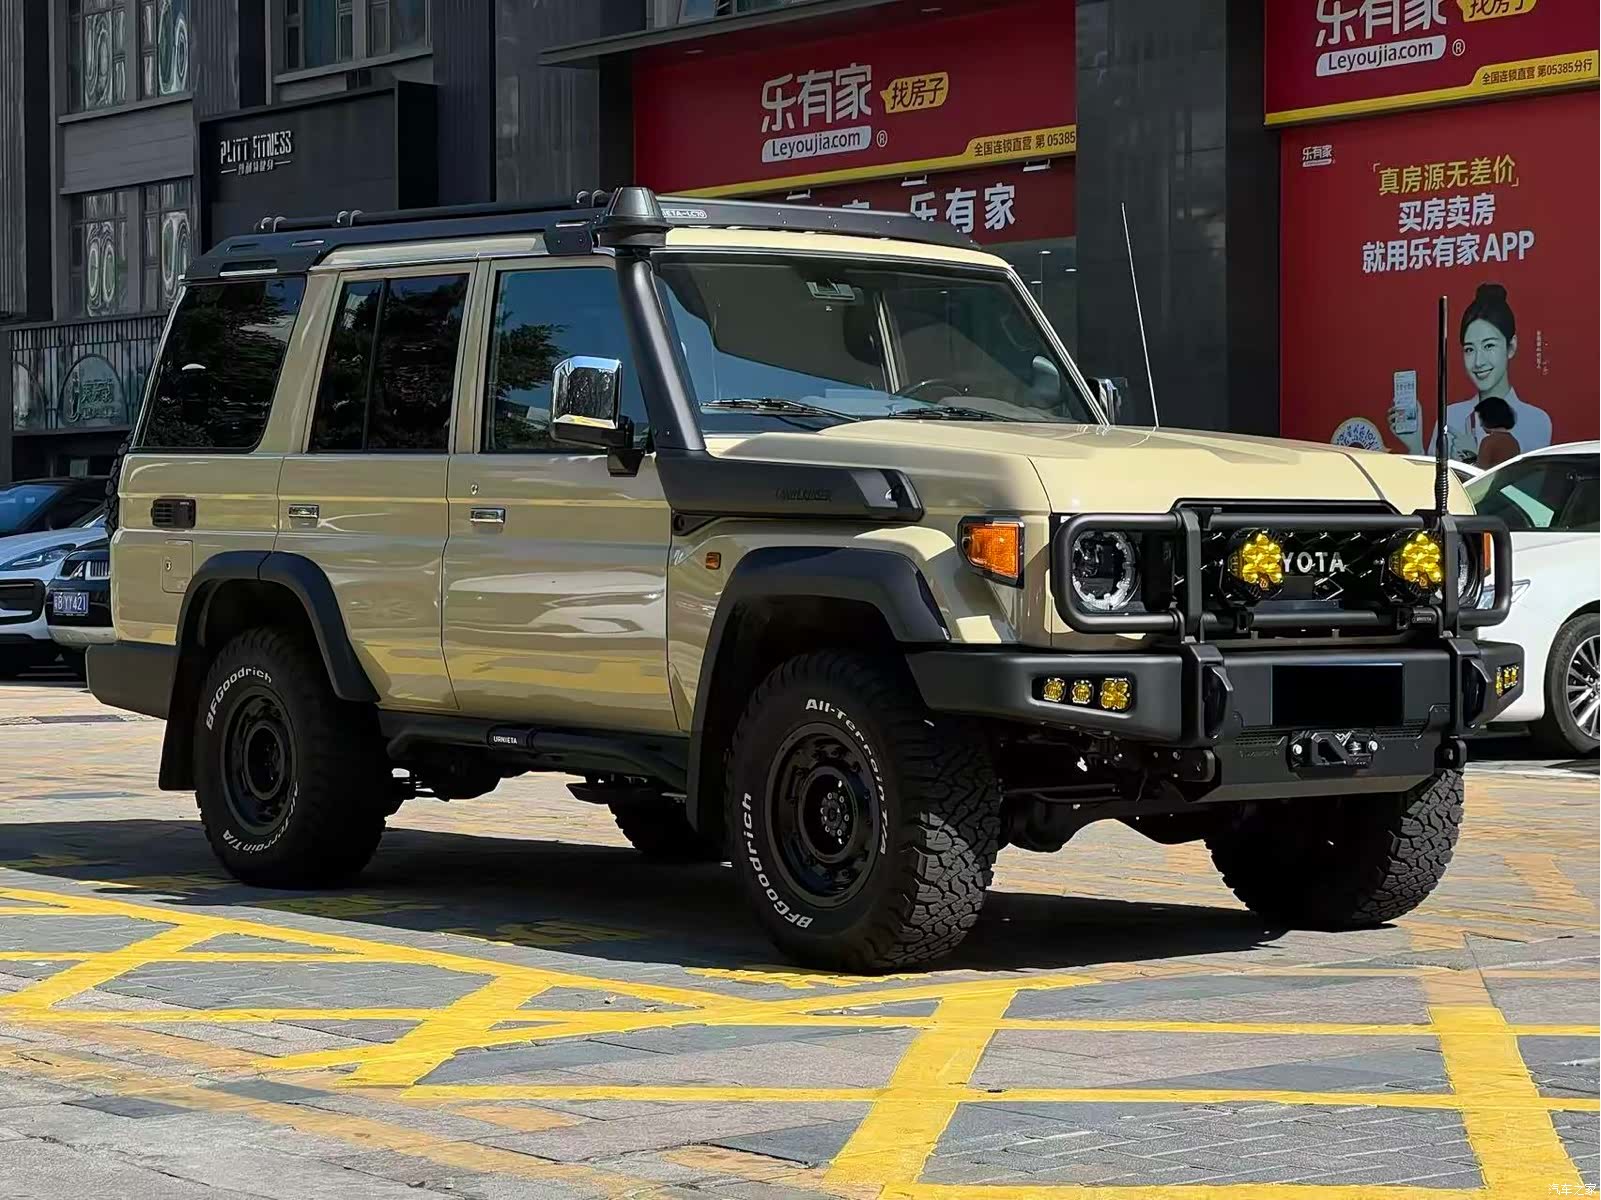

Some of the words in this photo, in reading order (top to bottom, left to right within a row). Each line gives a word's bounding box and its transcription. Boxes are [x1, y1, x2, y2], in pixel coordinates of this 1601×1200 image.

[1328, 40, 1433, 71] Leyoujia.com
[761, 62, 872, 133] 乐有家
[890, 77, 945, 110] 找房子
[253, 130, 292, 159] FITNESS
[772, 131, 860, 158] Leyoujia.com
[1398, 192, 1496, 234] 买房卖房
[1281, 551, 1345, 573] YOTA
[205, 666, 272, 730] BFGoodrich
[805, 698, 886, 802] All-Terrain
[741, 792, 814, 929] BFGoodrich
